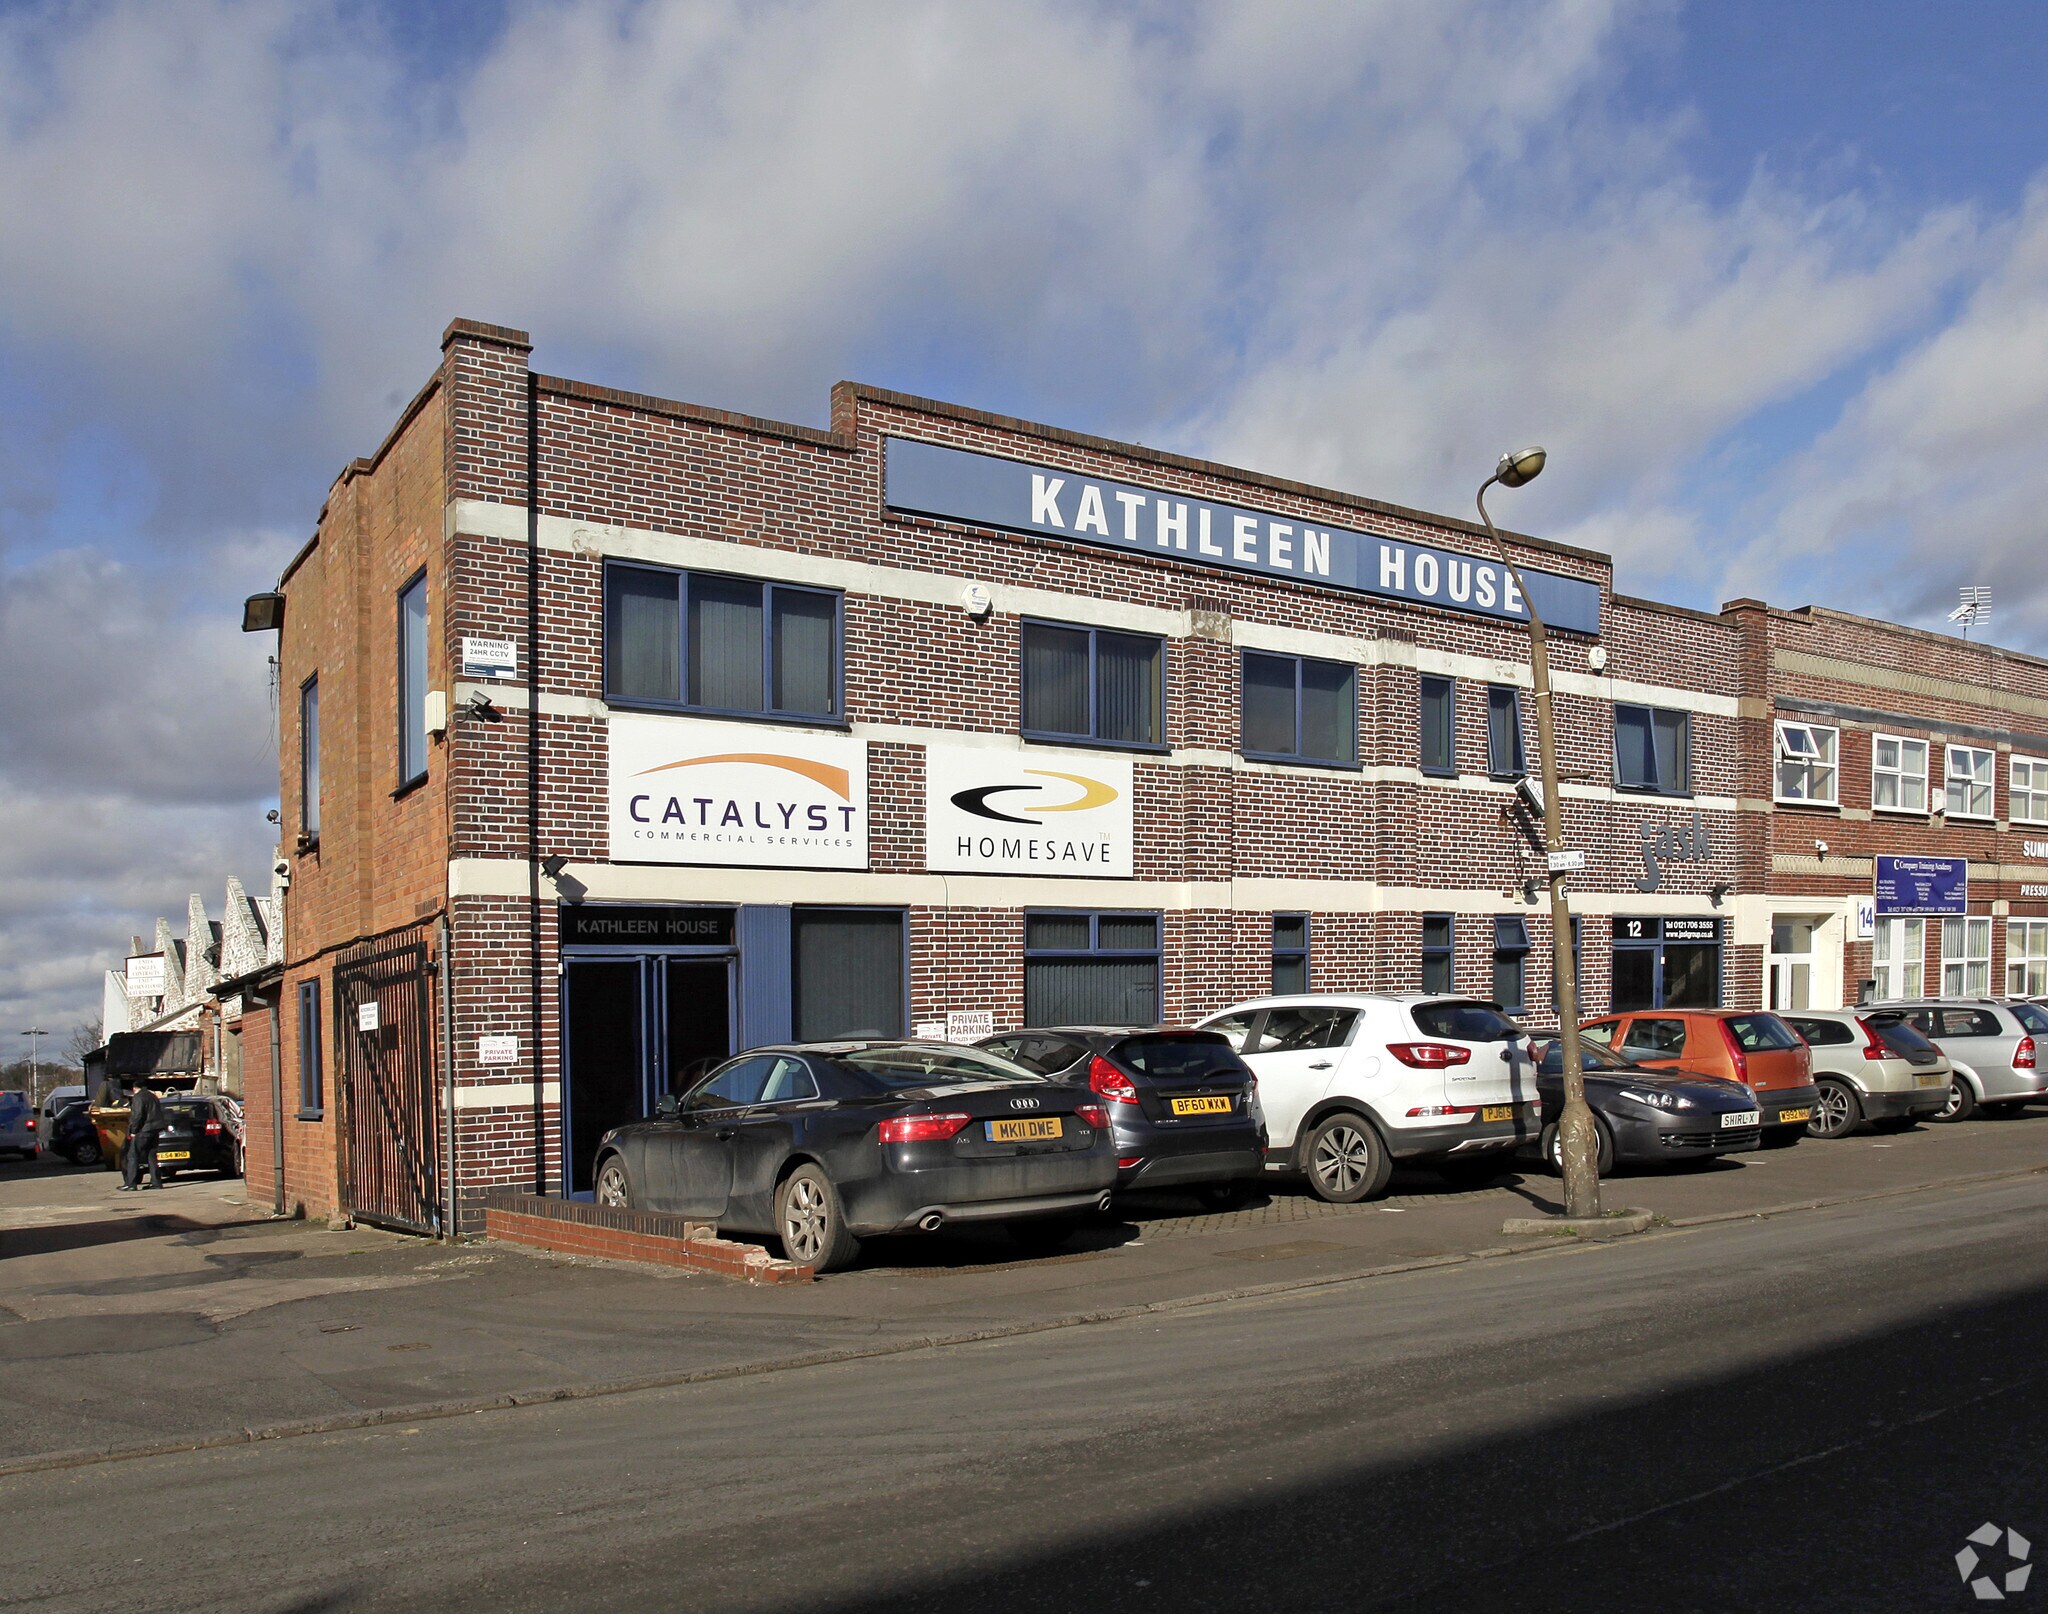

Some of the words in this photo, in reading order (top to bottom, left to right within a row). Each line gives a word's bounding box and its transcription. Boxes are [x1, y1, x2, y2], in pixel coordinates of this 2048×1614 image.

[1031, 473, 1330, 577] KATHLEEN
[1379, 545, 1523, 614] HOUSE
[470, 640, 509, 650] WARNING
[490, 650, 509, 658] CCTV
[630, 794, 856, 832] CATALYST
[634, 830, 755, 844] COMMERCIAL
[767, 836, 852, 847] SERVICES
[958, 836, 1111, 863] HOMESAVE
[1635, 812, 1712, 892] jask
[1673, 921, 1686, 929] 0121
[1699, 921, 1714, 929] 3555
[1860, 906, 1874, 929] 14
[577, 920, 658, 933] KATHLEEN
[666, 921, 718, 934] HOUSE
[1627, 920, 1642, 937] 12
[952, 1014, 989, 1024] PRIVATE
[950, 1024, 991, 1035] PARKING
[1177, 1098, 1205, 1111] BF60
[1029, 1121, 1055, 1137] DWE
